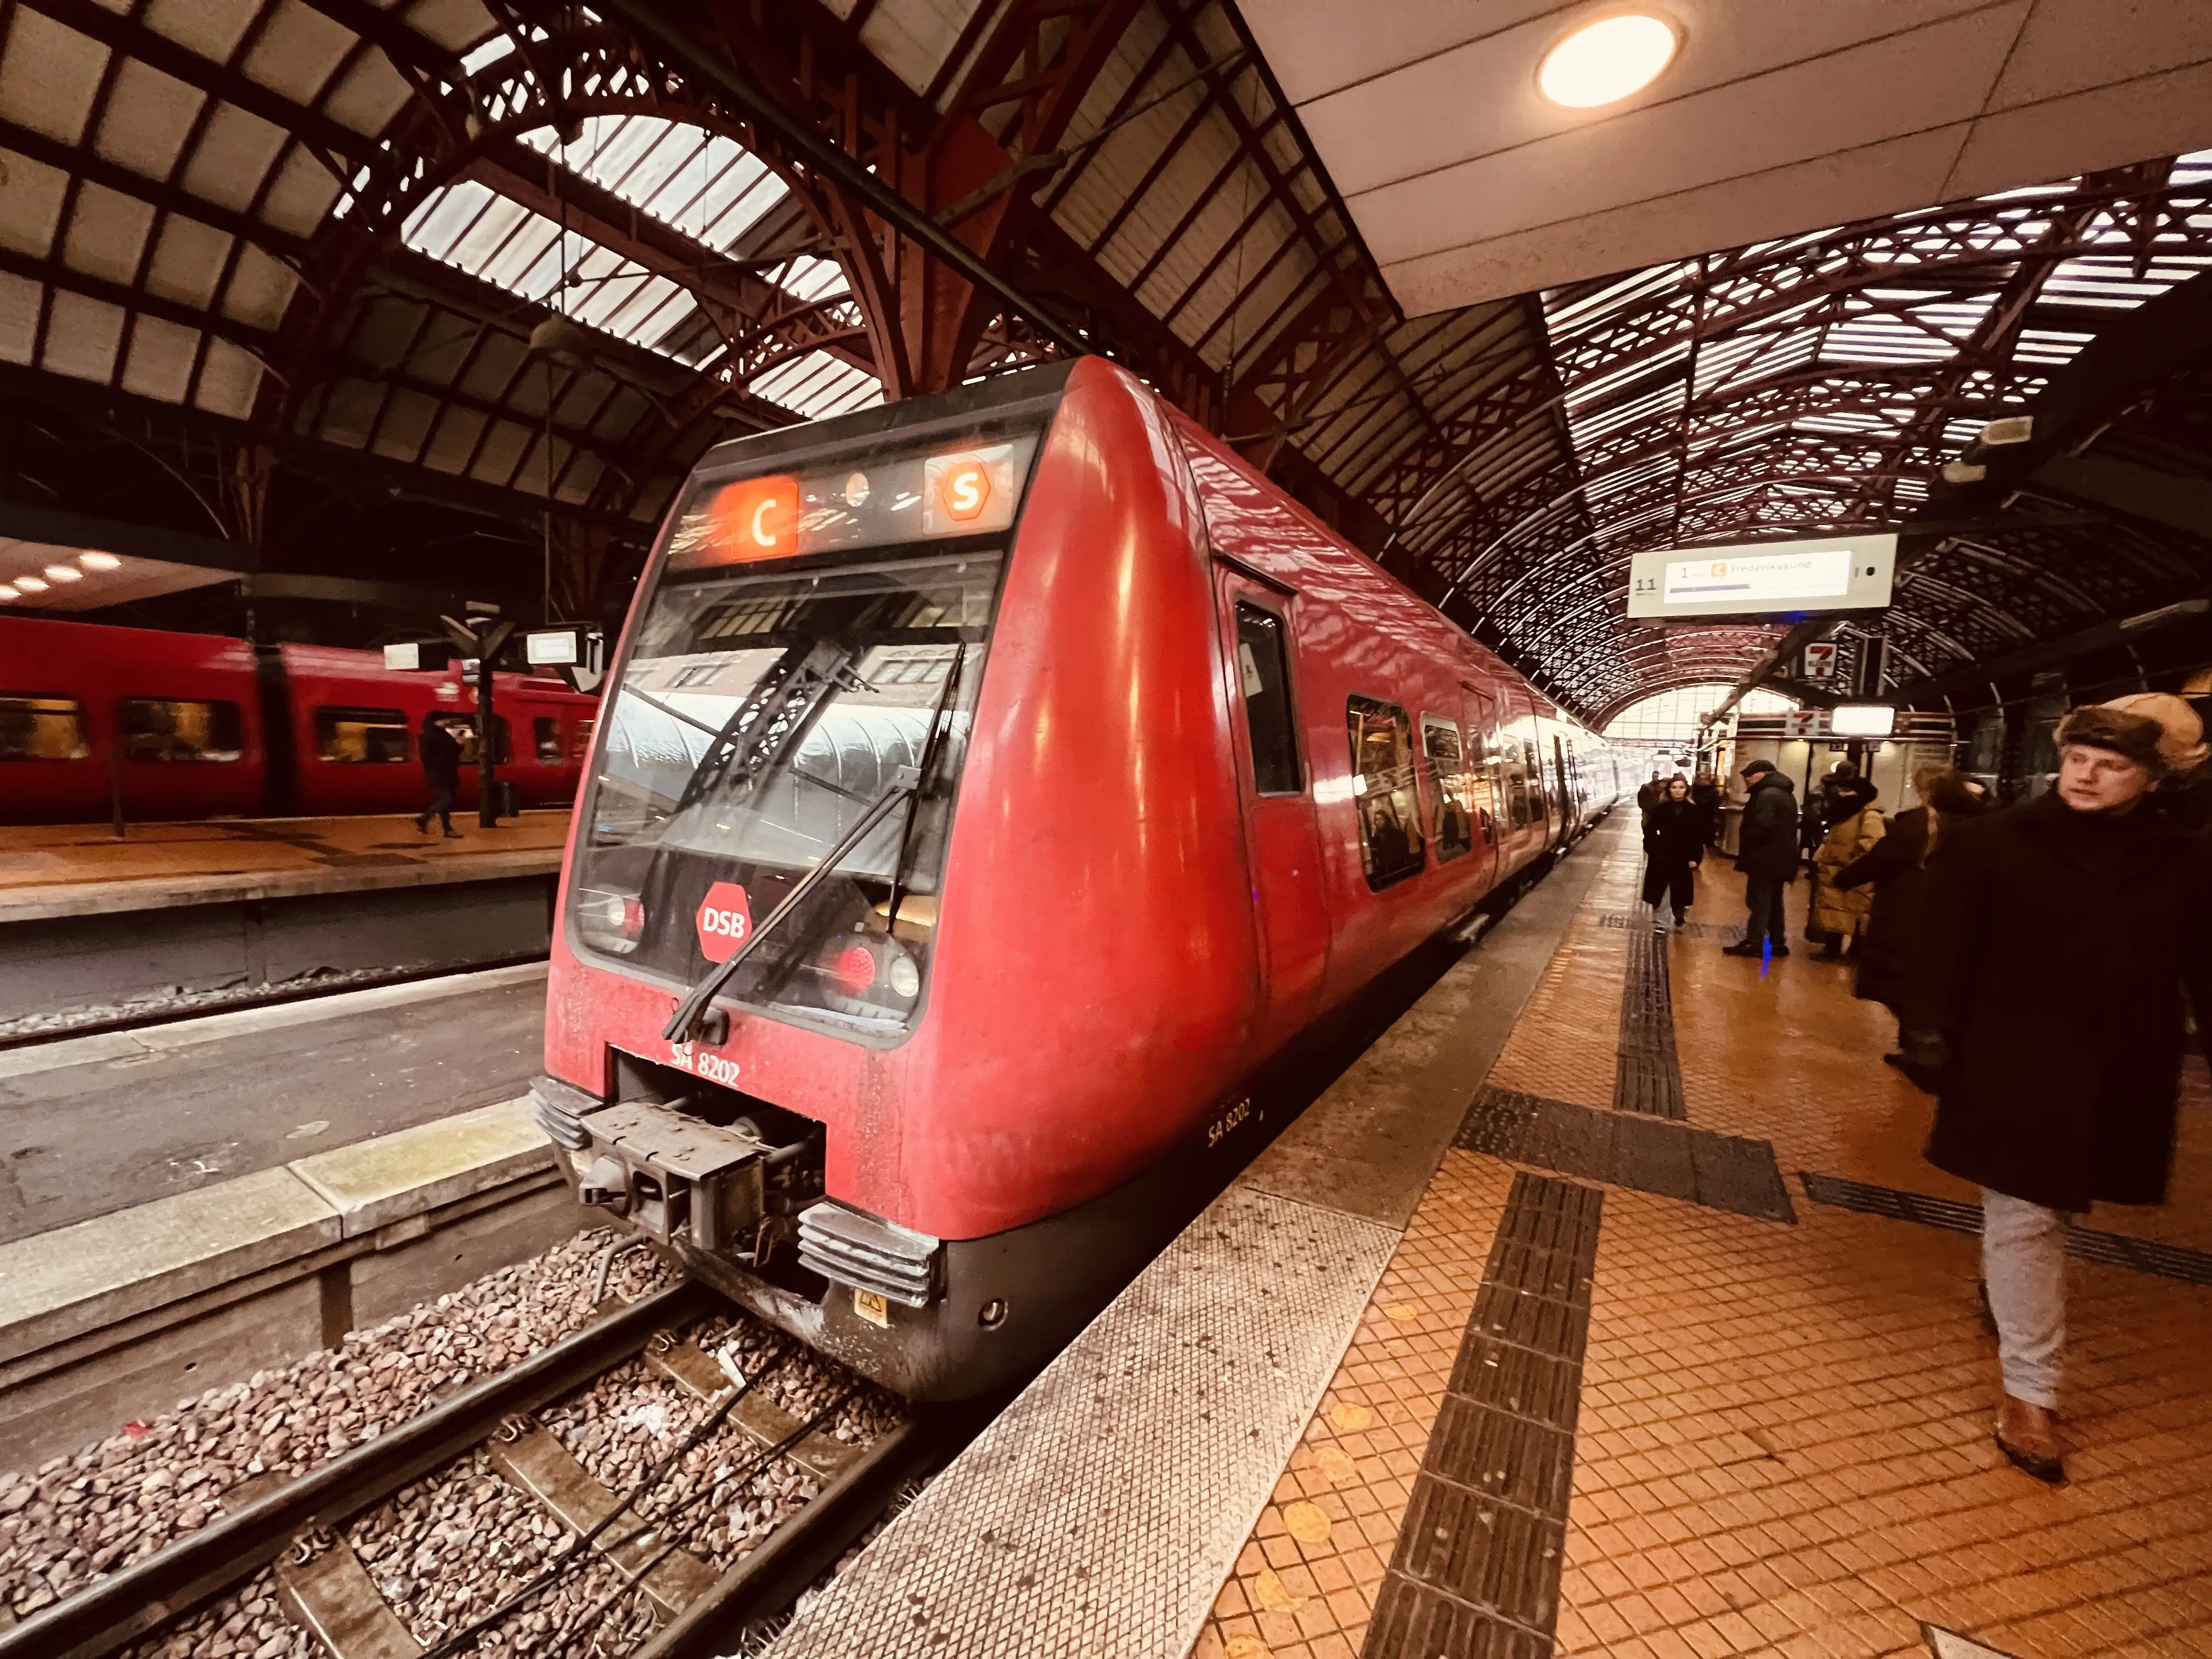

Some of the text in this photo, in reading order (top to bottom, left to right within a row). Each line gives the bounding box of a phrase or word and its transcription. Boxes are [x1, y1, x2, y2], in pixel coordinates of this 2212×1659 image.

[953, 472, 979, 510] S
[751, 499, 777, 546] C
[1635, 578, 1656, 591] 11
[1810, 646, 1833, 676] 7
[1792, 713, 1814, 735] 7
[702, 907, 746, 938] DSB
[697, 1052, 740, 1088] 8202
[1208, 1097, 1250, 1148] SA 8202
